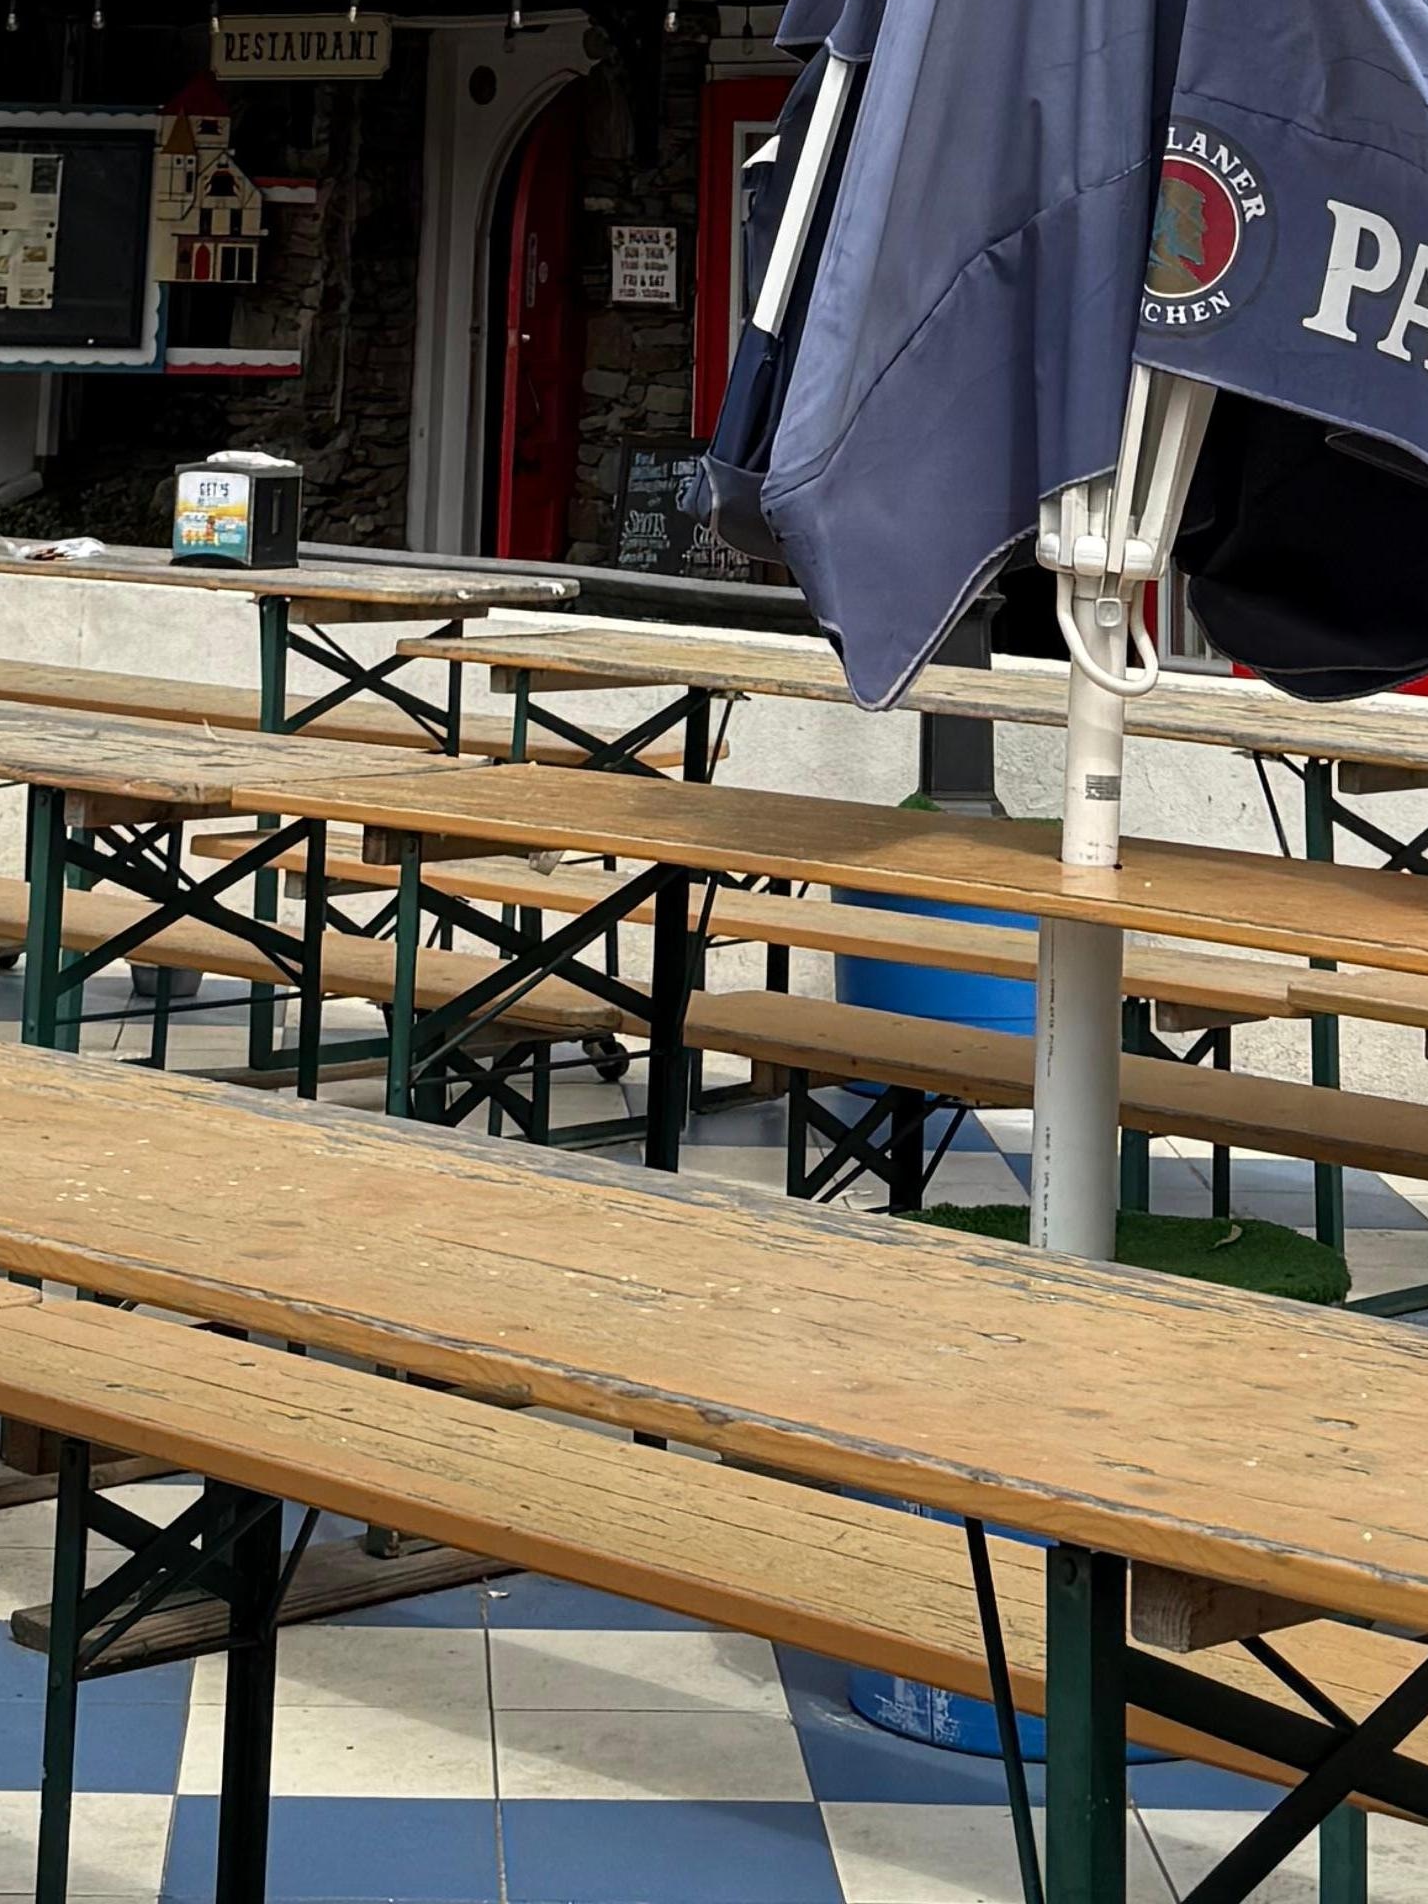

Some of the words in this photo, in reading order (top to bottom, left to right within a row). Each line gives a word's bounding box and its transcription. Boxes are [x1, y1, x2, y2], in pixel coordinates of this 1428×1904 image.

[224, 31, 379, 62] RESTAURANT
[1166, 127, 1266, 223] LANER
[1140, 290, 1231, 324] CHEN
